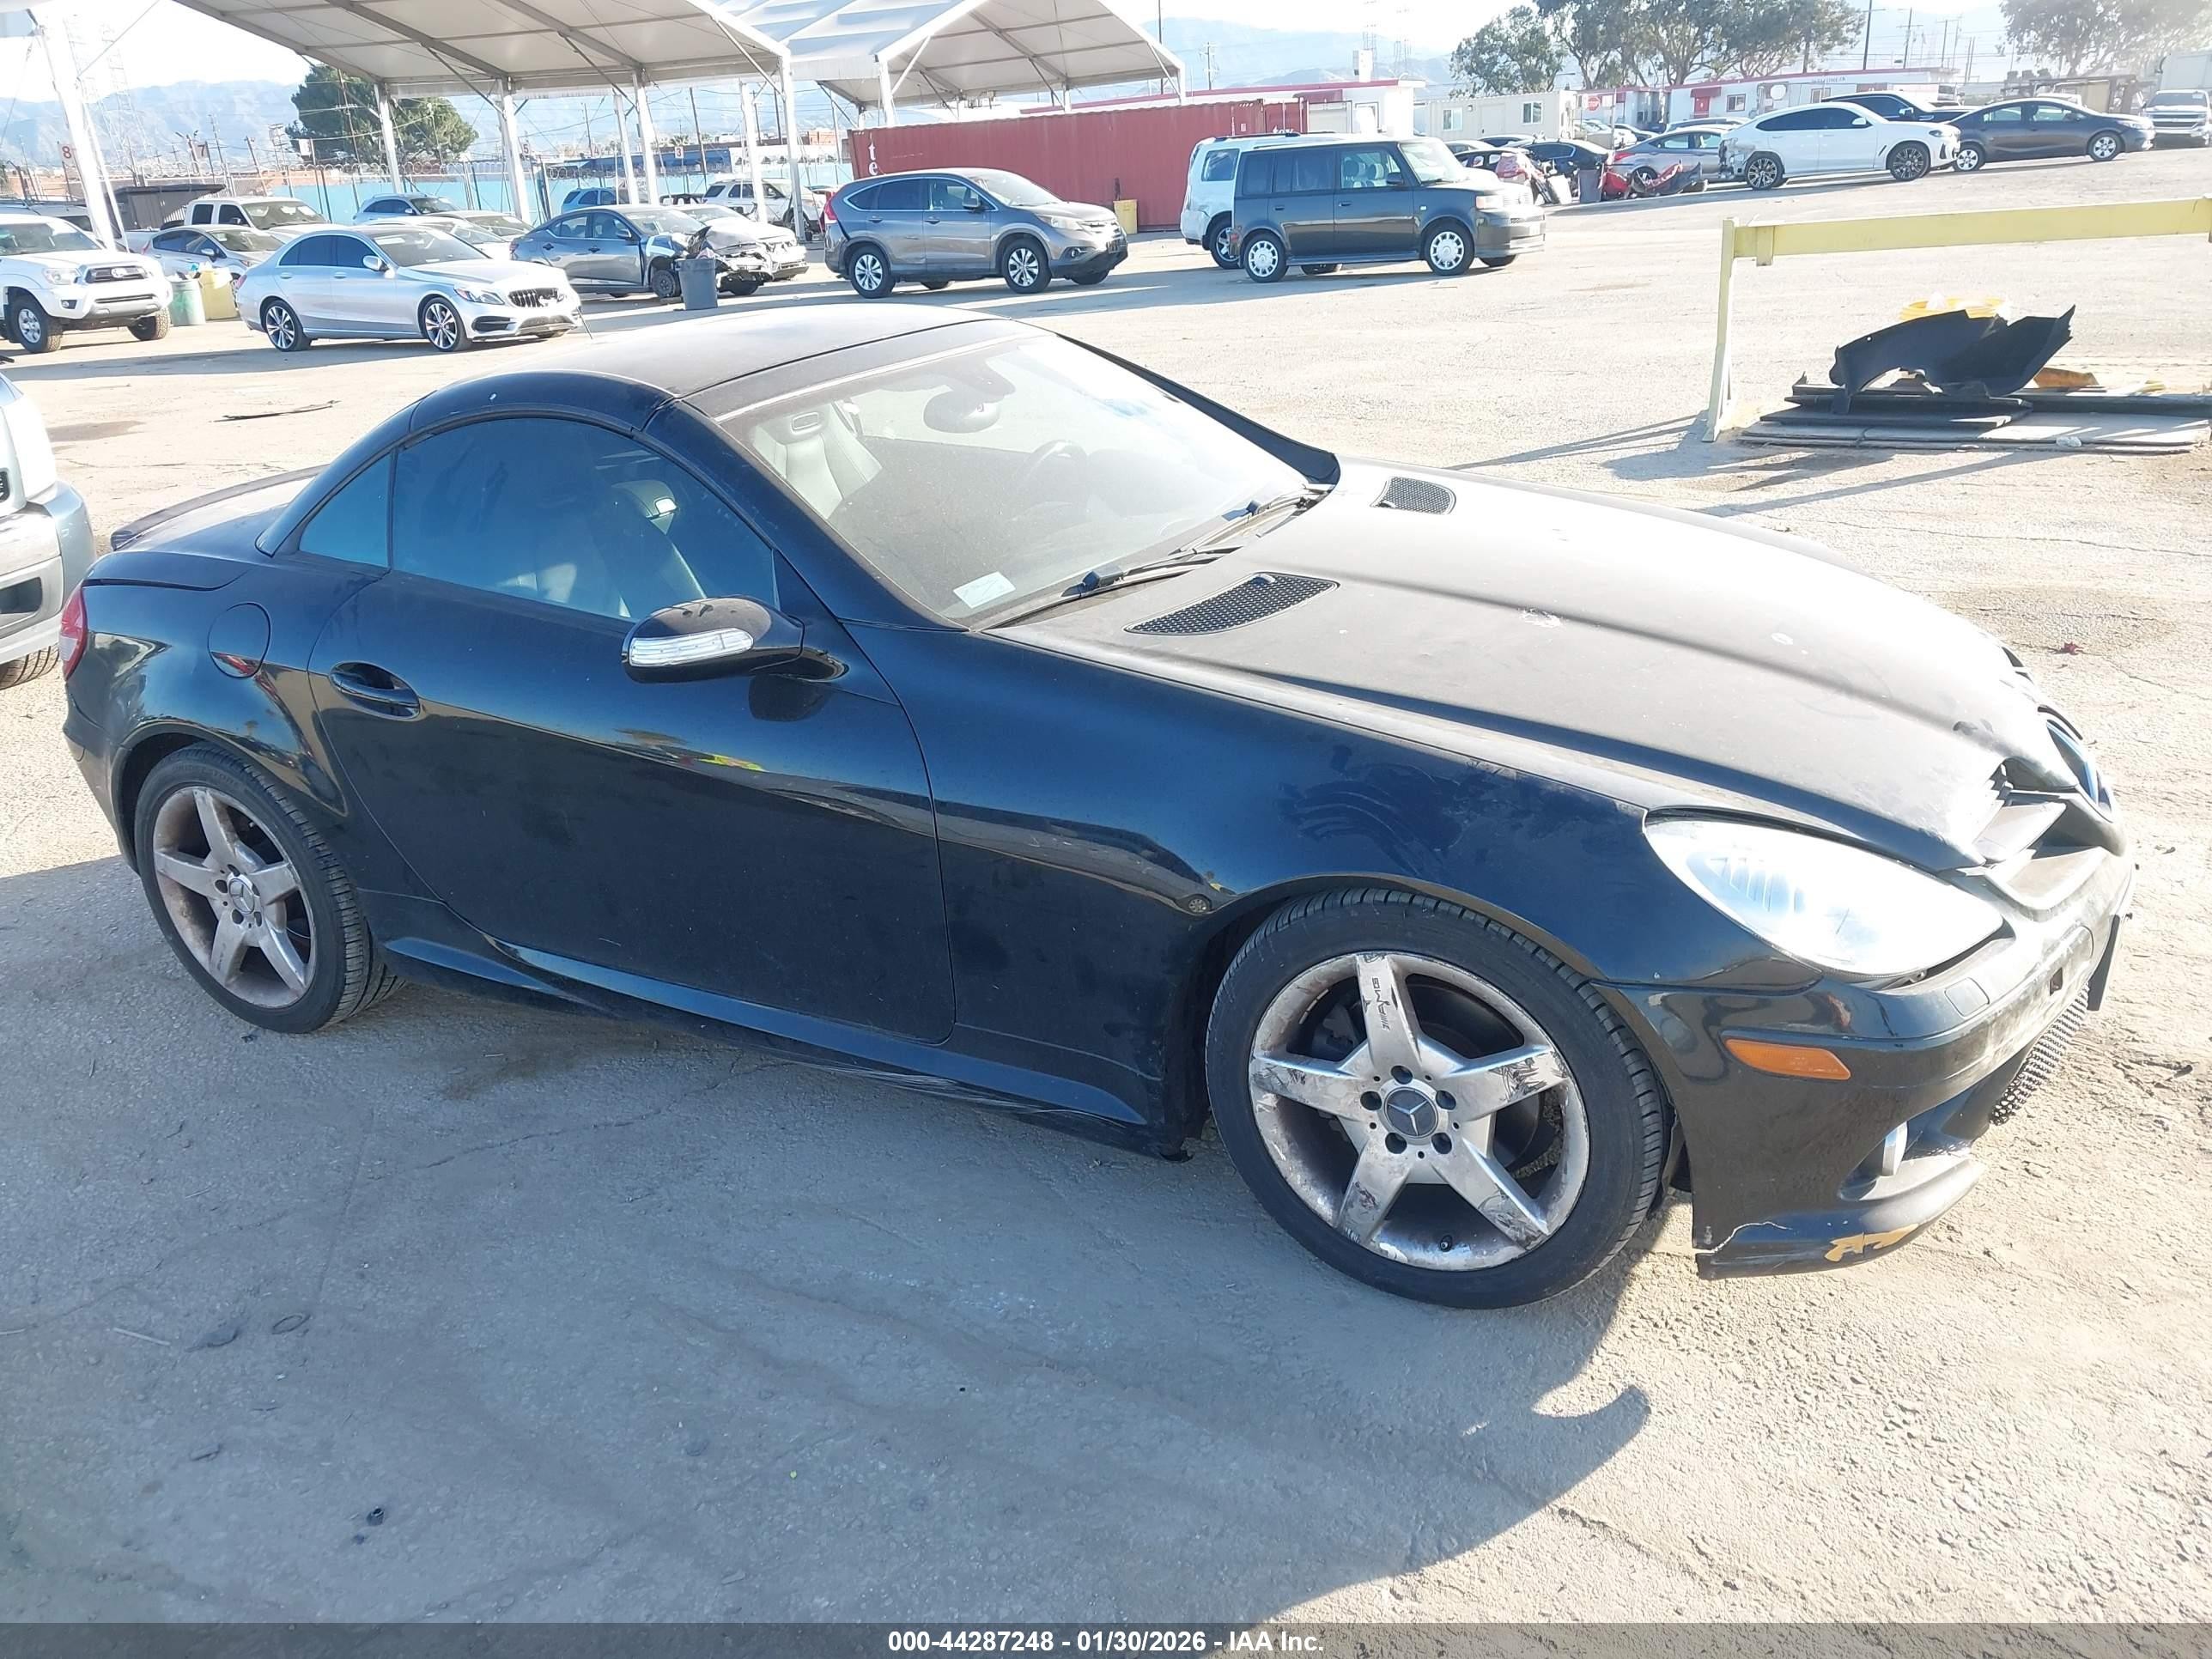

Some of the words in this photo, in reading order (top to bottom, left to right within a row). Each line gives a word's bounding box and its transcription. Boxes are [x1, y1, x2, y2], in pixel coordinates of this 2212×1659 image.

[62, 146, 71, 159] 8
[198, 144, 205, 156] 7
[523, 143, 529, 154] 5
[676, 148, 682, 157] 3
